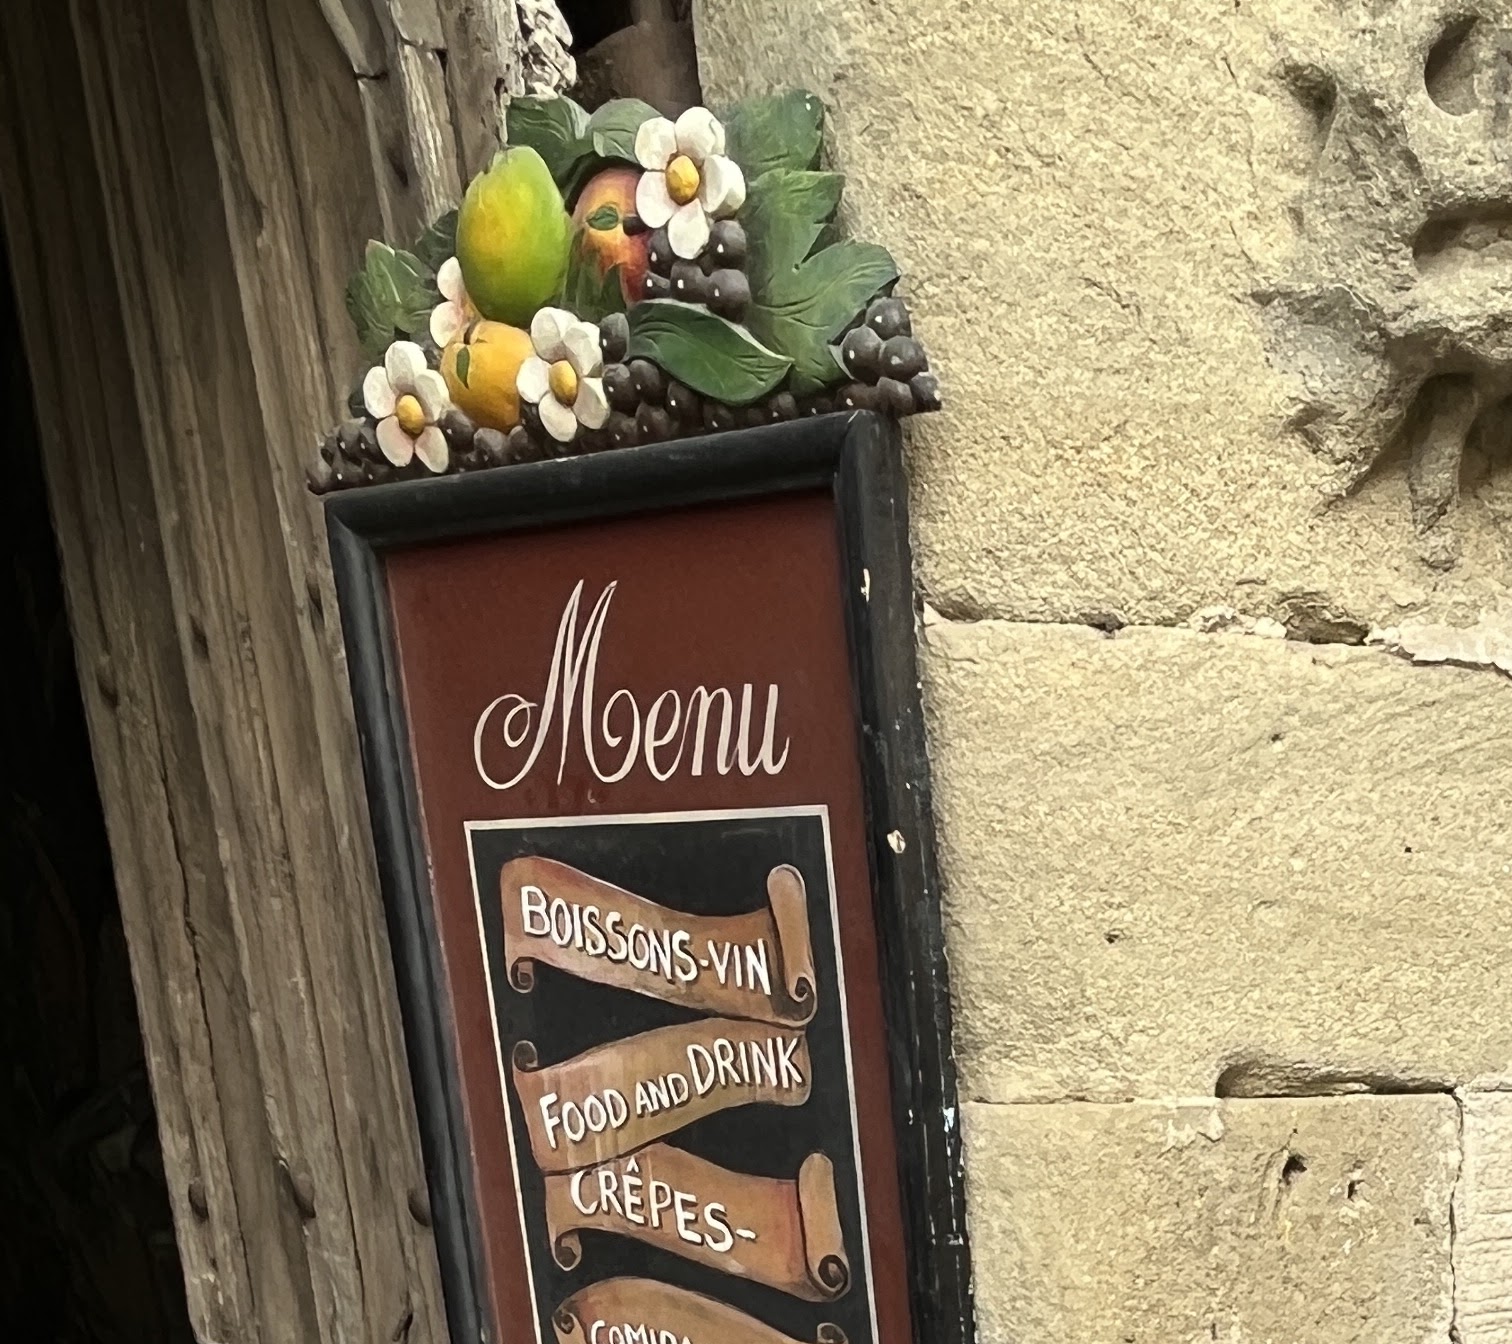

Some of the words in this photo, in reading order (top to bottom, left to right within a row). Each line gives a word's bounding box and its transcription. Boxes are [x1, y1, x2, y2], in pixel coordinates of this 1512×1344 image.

[474, 580, 789, 789] Menu
[520, 886, 771, 995] BOISSONS-VIN
[540, 1089, 629, 1149] FOOD
[636, 1073, 688, 1114] AND
[687, 1037, 802, 1089] DRINK
[570, 1160, 757, 1252] CRÊPES-
